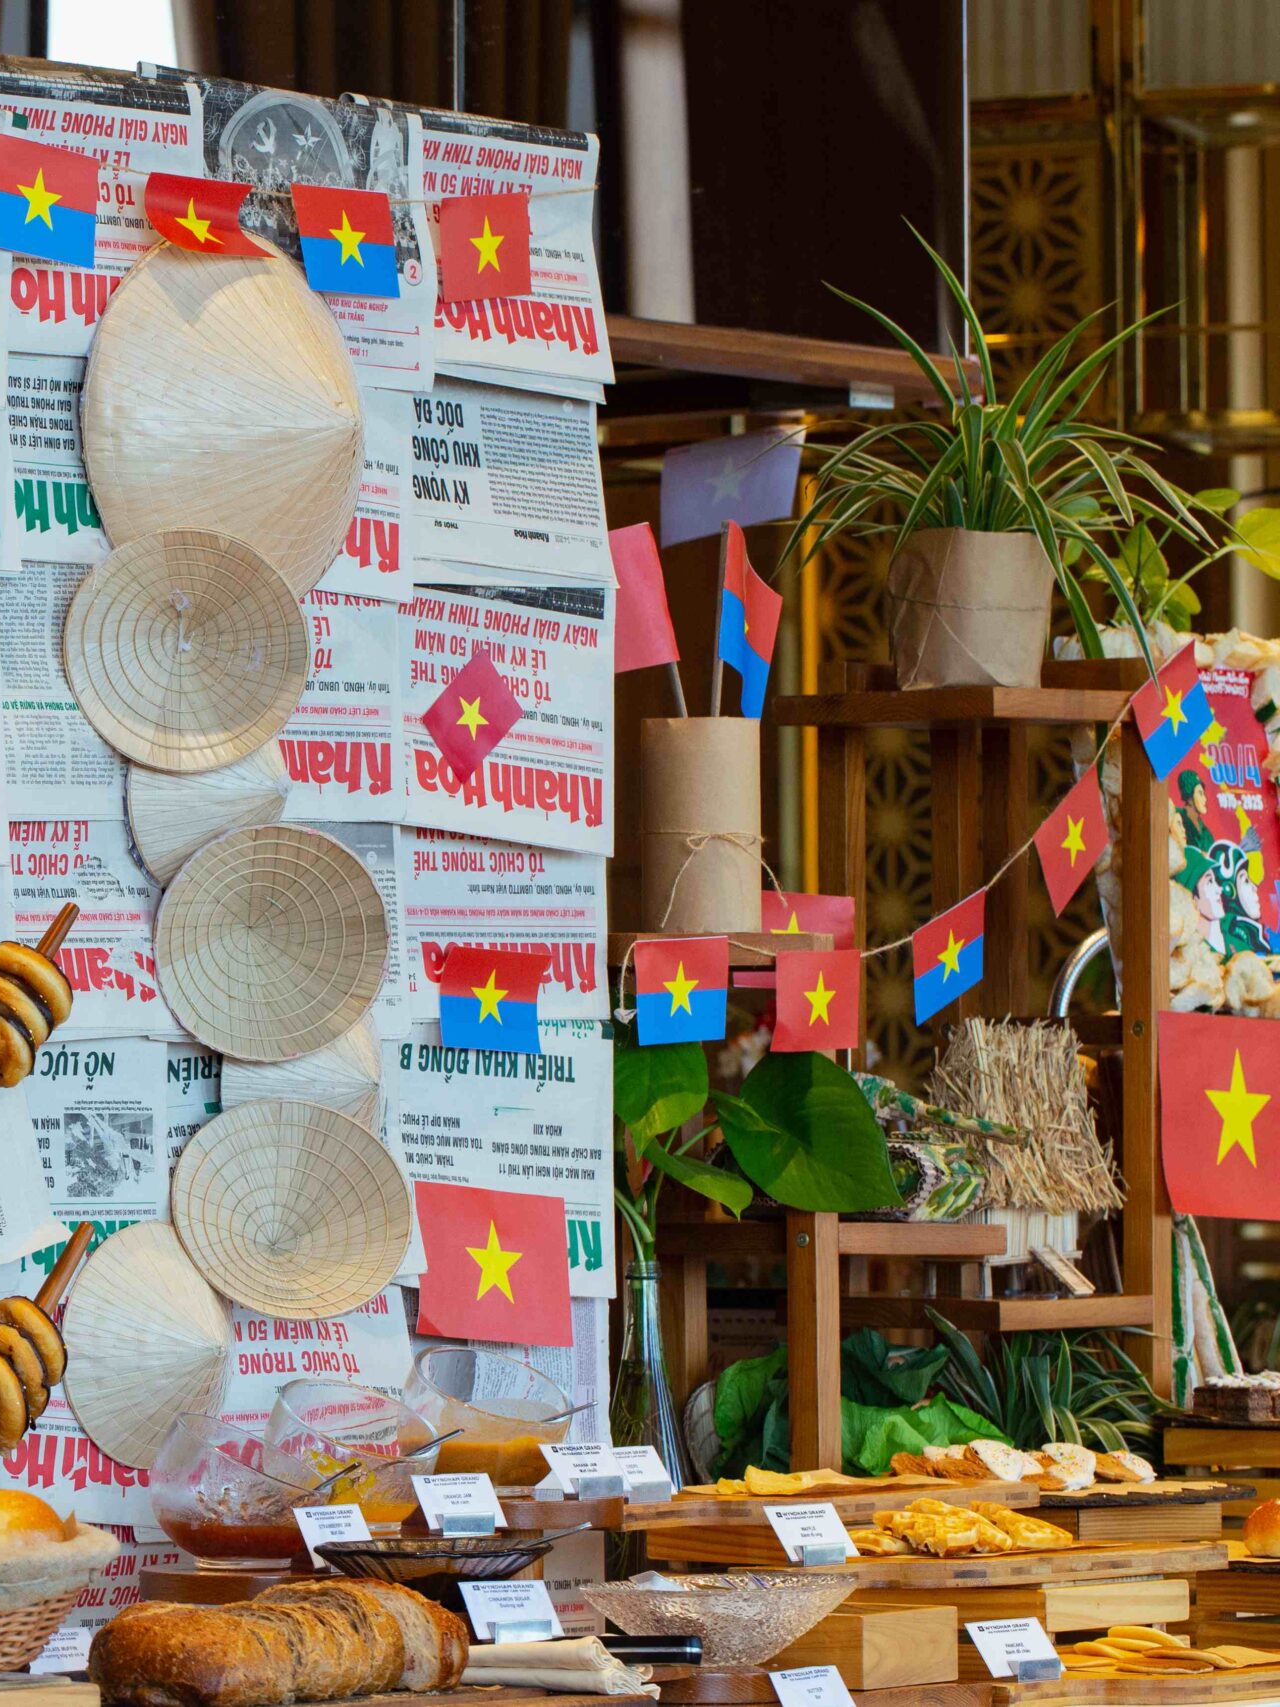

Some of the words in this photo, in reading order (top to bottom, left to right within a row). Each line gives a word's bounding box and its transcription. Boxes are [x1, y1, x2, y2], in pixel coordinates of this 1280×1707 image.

[61, 112, 115, 141] PHÓNG
[121, 118, 148, 145] GIẢI
[152, 123, 188, 149] NGÀY
[444, 143, 474, 171] TỈNH
[478, 147, 522, 174] PHÓNG
[524, 155, 549, 178] GIẢI
[552, 158, 581, 182] NGÀY
[410, 267, 416, 279] 2
[489, 298, 599, 356] Khánh
[413, 397, 433, 426] ĐÁ
[436, 403, 464, 436] DỐC
[412, 436, 449, 468] CÔNG
[452, 441, 480, 468] KHU
[412, 470, 449, 505] VỌNG
[452, 479, 470, 510] KỲ
[317, 680, 339, 692] UBND,
[342, 681, 365, 692] HĐND,
[367, 681, 376, 694] ủy,
[378, 683, 390, 694] Tỉnh
[1207, 742, 1262, 788] 30/4
[413, 748, 487, 809] Hòa
[489, 762, 603, 828] Khánh
[413, 851, 438, 880] THỂ
[441, 847, 485, 872] TRỌNG
[490, 852, 524, 878] CHỨC
[529, 852, 545, 882] TỔ
[418, 1044, 469, 1084] ĐỒNG
[474, 1049, 518, 1078] KHAI
[525, 1053, 575, 1092] TRIỂN
[420, 1135, 435, 1147] GIÁO
[436, 1134, 451, 1147] MỤC
[533, 1124, 543, 1135] XIII
[545, 1124, 562, 1137] KHÓA
[452, 1136, 469, 1148] GIÁM
[471, 1137, 482, 1150] TÒA
[492, 1142, 509, 1156] ĐẢNG
[510, 1143, 528, 1156] ƯƠNG
[529, 1144, 550, 1157] TRUNG
[552, 1146, 569, 1160] HÀNH
[570, 1147, 588, 1163] CHẤP
[589, 1148, 601, 1161] BAN
[498, 1163, 506, 1174] 11
[507, 1163, 520, 1177] THỨ
[522, 1164, 534, 1180] LẦN
[535, 1163, 551, 1176] NGHỊ
[552, 1164, 564, 1178] HỘI
[565, 1166, 580, 1178] MẠC
[581, 1169, 595, 1181] KHAI
[238, 1348, 297, 1375] TRỌNG
[301, 1351, 340, 1377] CHỨC
[343, 1352, 360, 1382] TỔ
